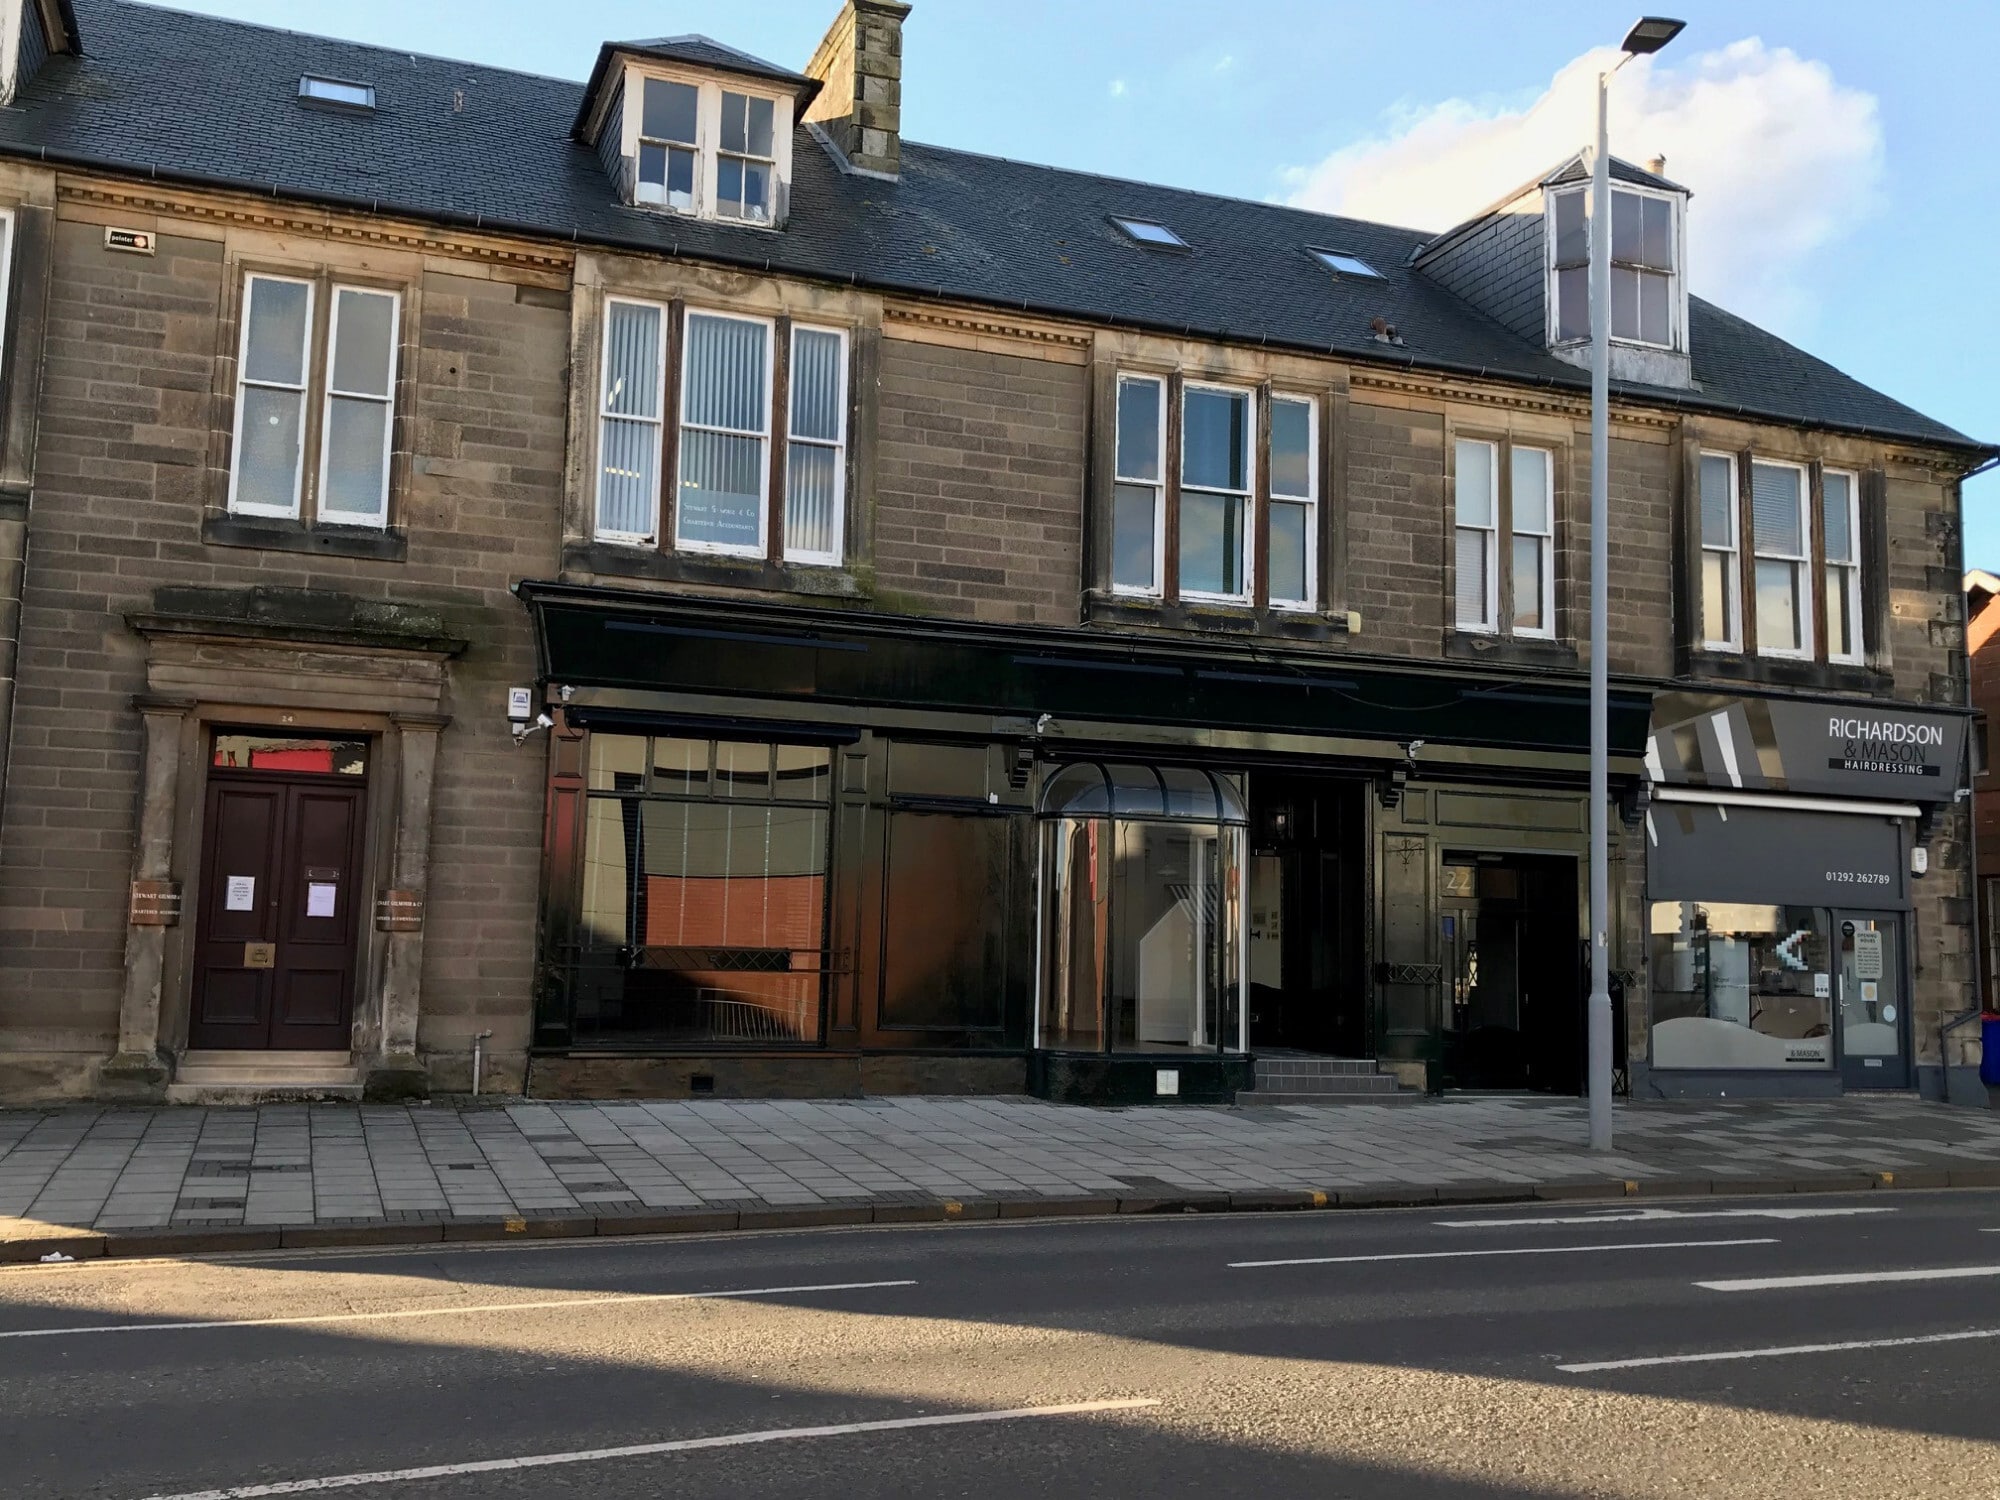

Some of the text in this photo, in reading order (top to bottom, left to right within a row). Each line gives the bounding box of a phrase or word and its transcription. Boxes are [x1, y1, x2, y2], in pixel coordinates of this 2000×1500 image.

[111, 235, 133, 243] pointer
[1829, 718, 1943, 745] RICHARDSON
[1844, 739, 1926, 763] & MASON
[1844, 760, 1923, 775] HAIRDRESSING
[1446, 871, 1472, 889] 22
[1825, 871, 1890, 885] 01292 262789
